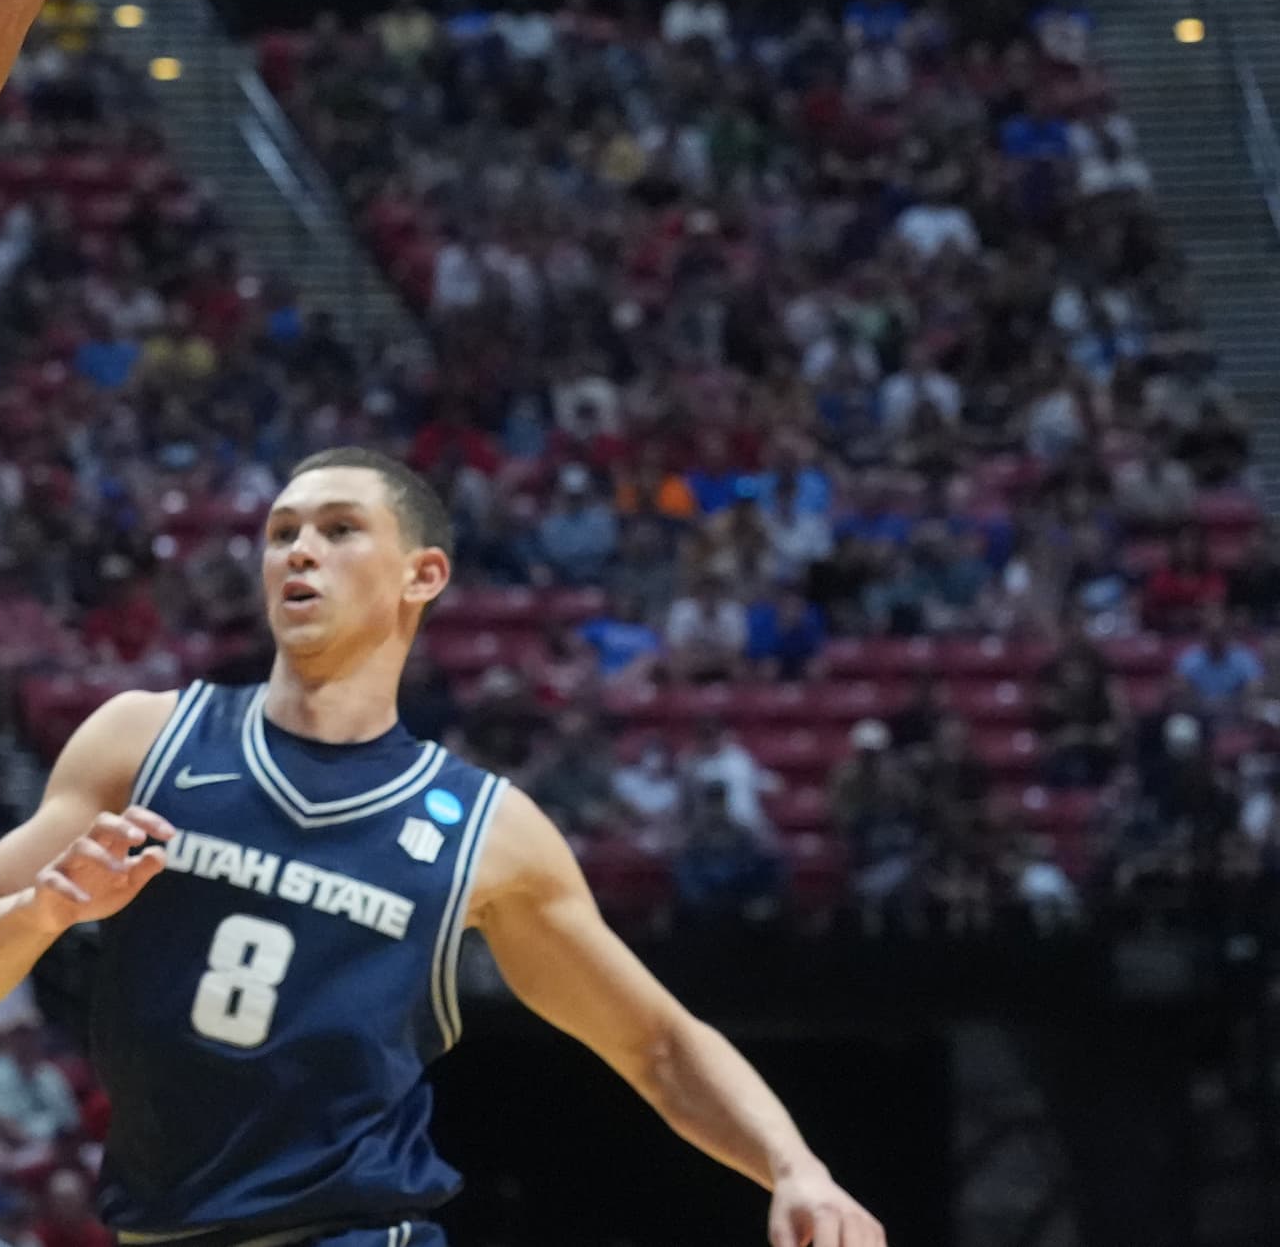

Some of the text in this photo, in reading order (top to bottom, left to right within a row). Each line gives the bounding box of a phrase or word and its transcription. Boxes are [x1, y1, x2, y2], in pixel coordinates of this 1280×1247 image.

[164, 830, 415, 940] UTAH STATE
[192, 913, 295, 1048] 8
